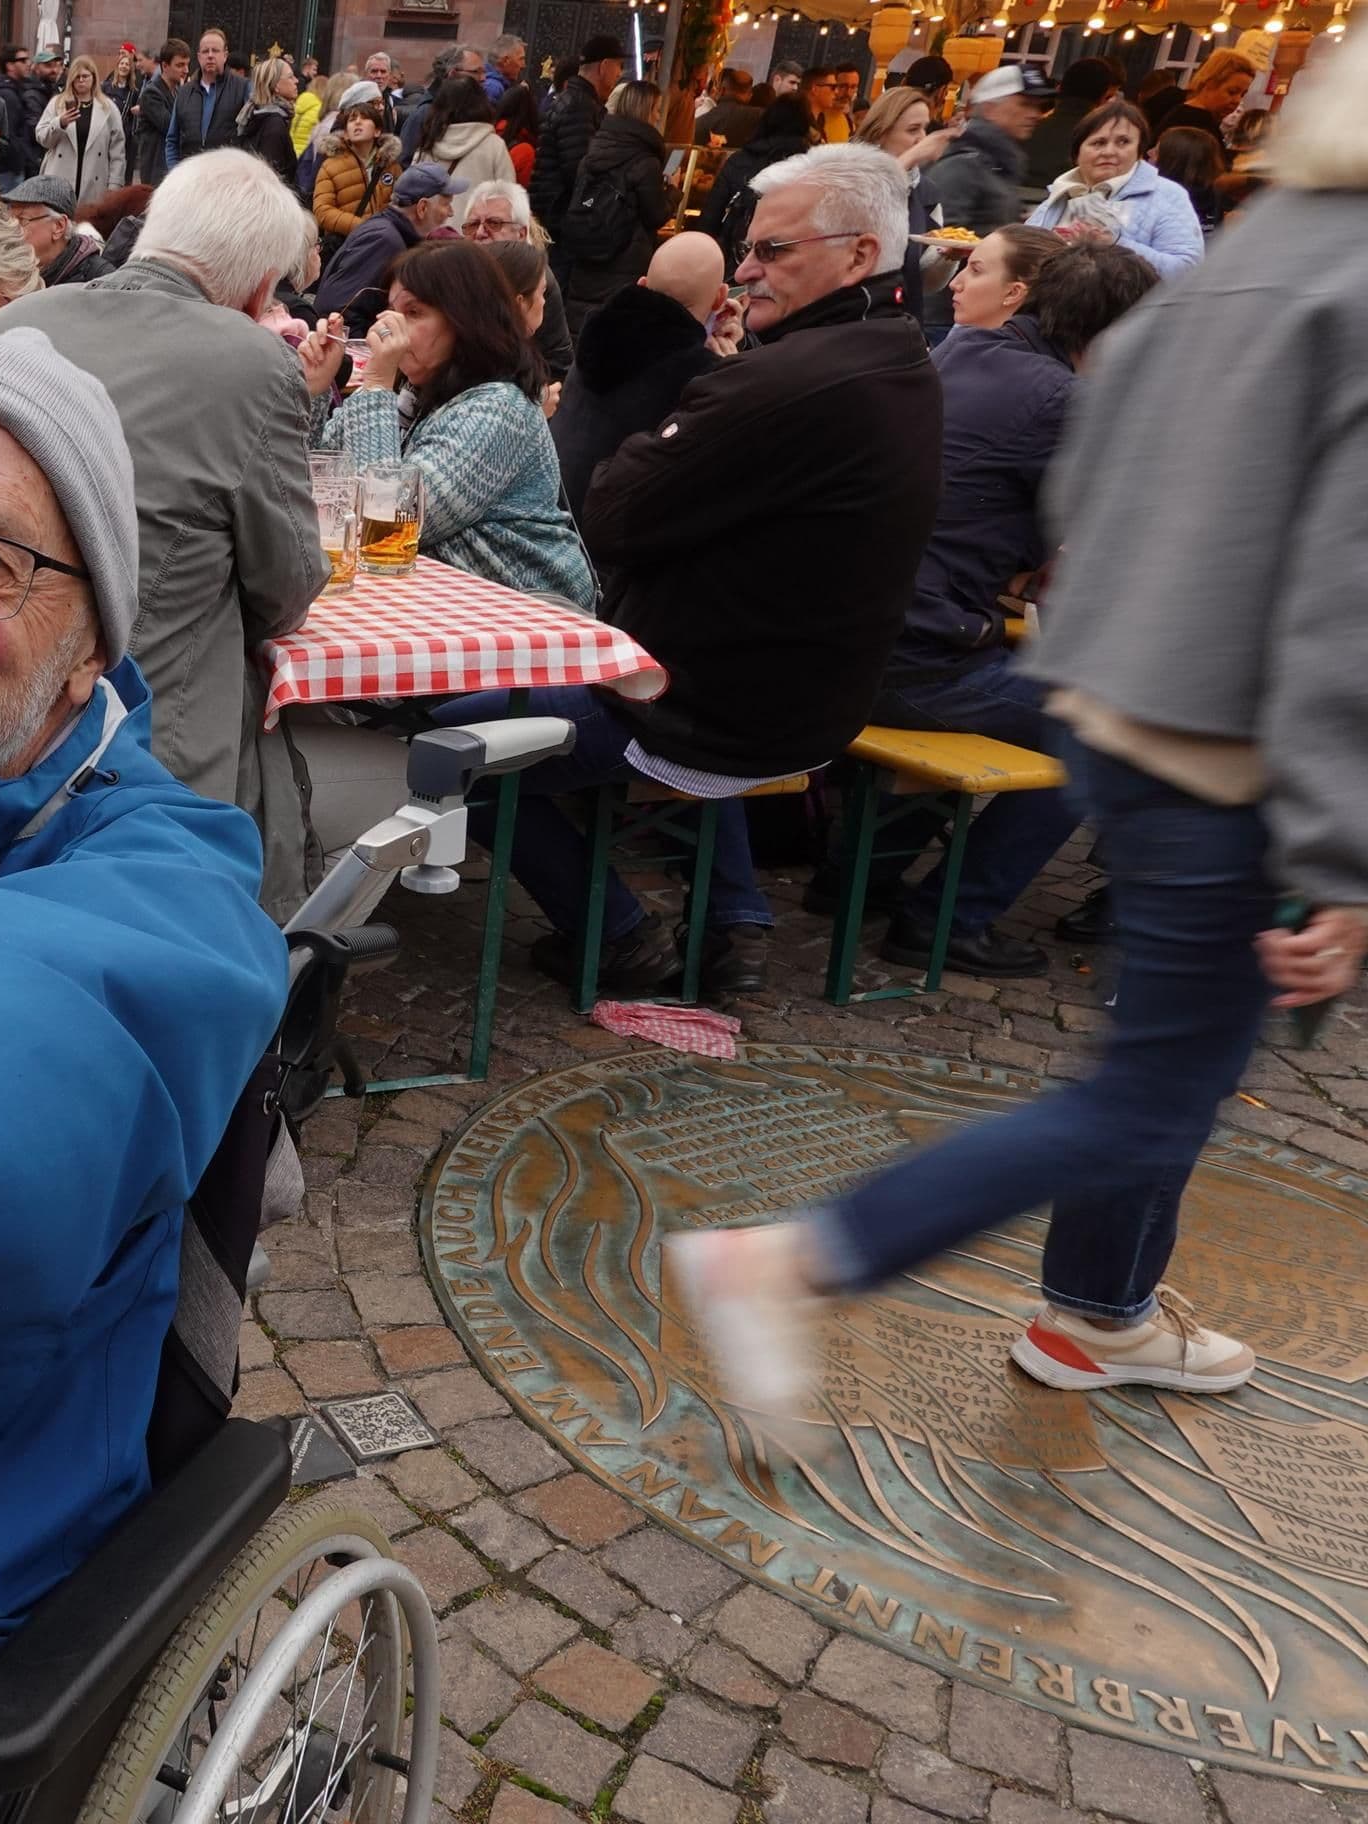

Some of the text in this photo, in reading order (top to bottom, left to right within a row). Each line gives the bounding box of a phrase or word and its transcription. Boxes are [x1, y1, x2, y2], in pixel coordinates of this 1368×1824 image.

[742, 1045, 808, 1063] AS
[812, 1047, 934, 1072] WAR
[448, 1069, 600, 1179] MENSCHEN
[695, 1163, 762, 1187] VON
[436, 1183, 483, 1270] AUCH
[449, 1278, 544, 1373] ENDE
[530, 1386, 629, 1446] AM
[617, 1460, 785, 1568] MAN
[1234, 1473, 1353, 1508] MEYRINK
[1288, 1542, 1368, 1572] RAVEN
[792, 1566, 1332, 1768] VERBRENNT
